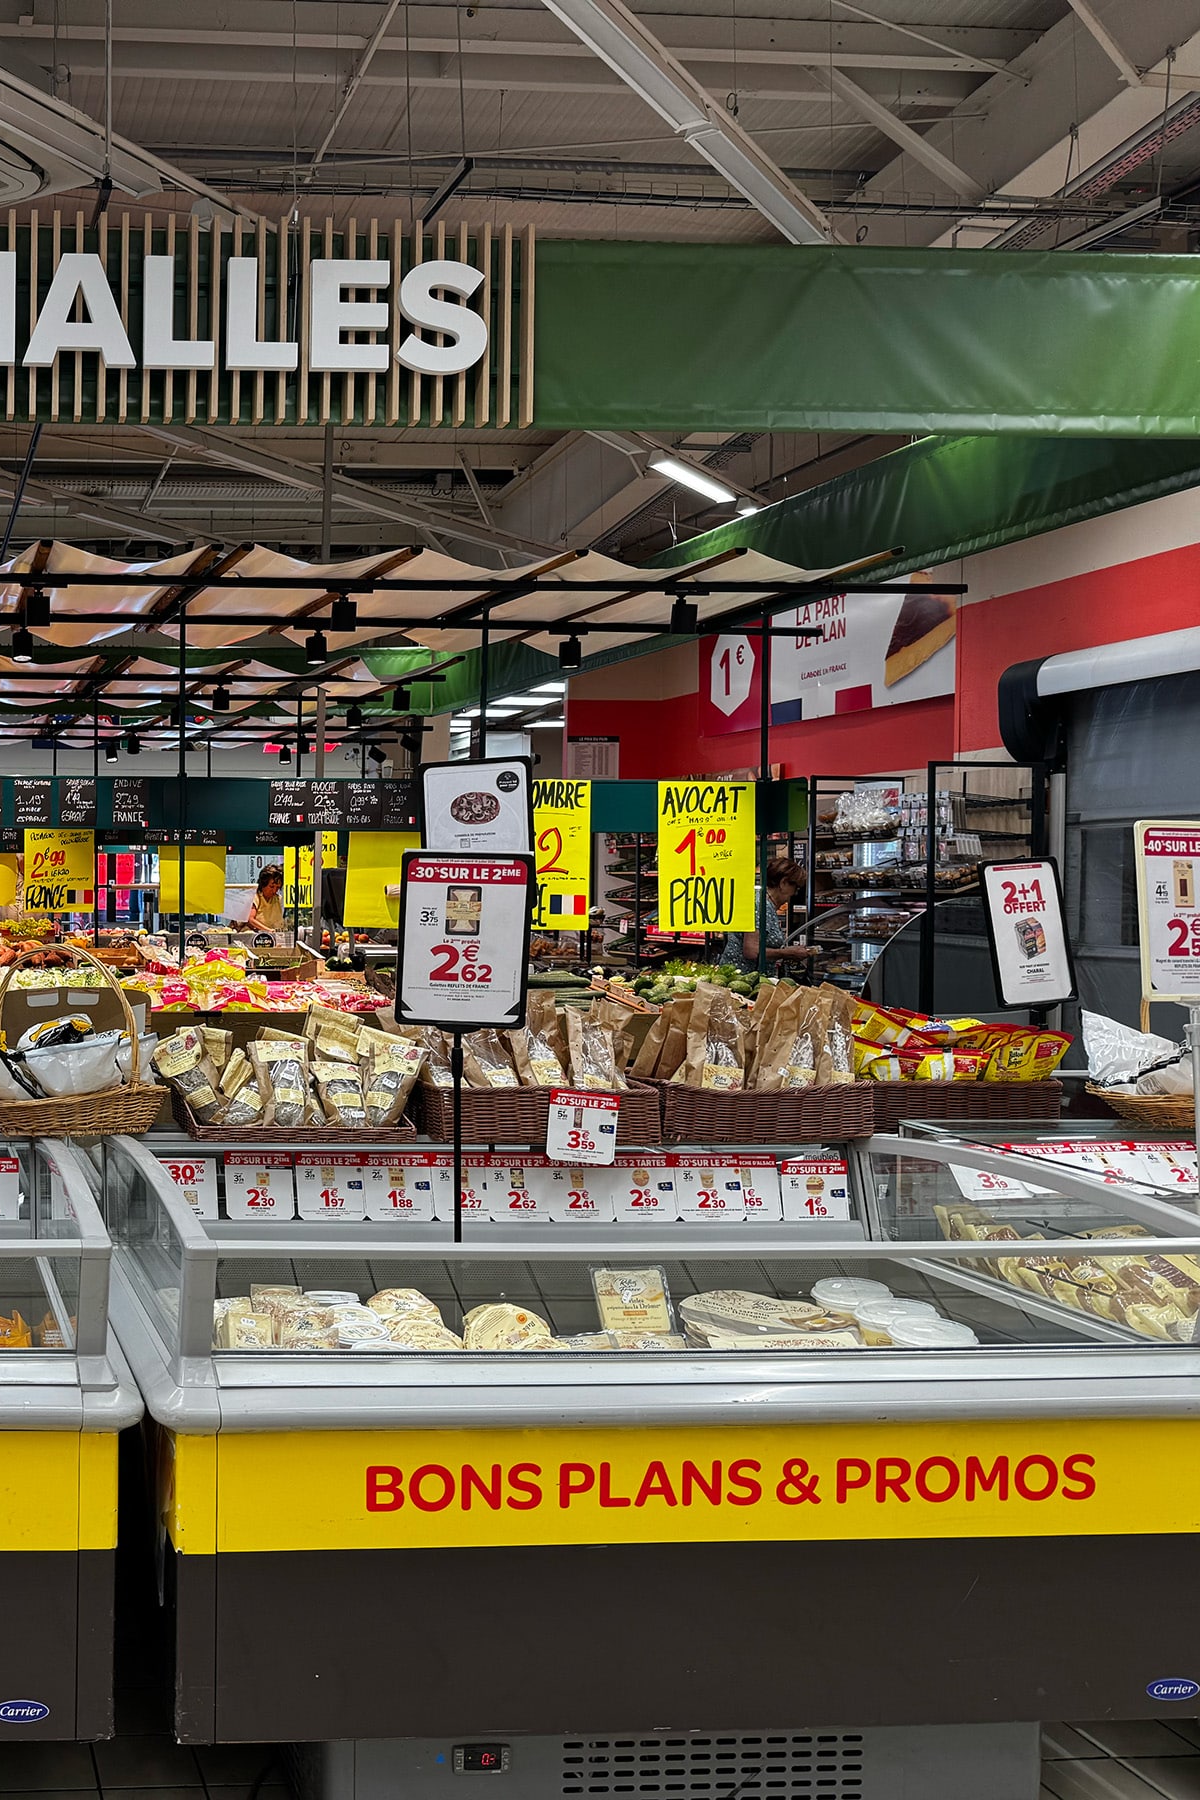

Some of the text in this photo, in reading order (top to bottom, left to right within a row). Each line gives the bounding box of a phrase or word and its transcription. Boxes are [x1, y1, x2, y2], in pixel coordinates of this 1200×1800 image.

[795, 593, 847, 627] LA PART
[795, 628, 811, 651] DE
[828, 662, 847, 674] FRANCE
[113, 779, 143, 788] ENDIVE
[311, 781, 337, 792] AVOCAT
[533, 781, 587, 810] OMBRE
[662, 786, 747, 818] AVOCAT
[112, 811, 144, 822] FRANCE
[1165, 840, 1187, 852] SUR
[410, 866, 439, 878] -30%
[439, 867, 470, 880] SUR
[473, 868, 490, 880] LE
[492, 866, 521, 881] 2ÈME
[25, 884, 68, 911] FRANCE
[1000, 879, 1043, 904] 2+1
[670, 876, 735, 927] PEROU
[1003, 900, 1047, 914] OFFERT
[429, 944, 493, 983] 2€62
[569, 1098, 587, 1106] SUR
[567, 1130, 596, 1150] 3€59
[243, 1157, 261, 1165] SUR
[262, 1157, 273, 1165] LE
[314, 1158, 332, 1166] SUR
[333, 1158, 343, 1166] LE
[382, 1158, 399, 1166] SUR
[400, 1158, 411, 1166] LE
[503, 1159, 520, 1167] SUR
[521, 1159, 532, 1167] LE
[691, 1159, 708, 1167] SUR
[710, 1159, 720, 1167] LE
[246, 1186, 275, 1207] 2€30
[320, 1187, 345, 1208] 1€97
[388, 1189, 413, 1208] 1€88
[508, 1189, 537, 1209] 2€62
[568, 1190, 595, 1209] 2€41
[630, 1189, 658, 1207] 2€99
[697, 1190, 726, 1209] 2€30
[365, 1453, 1096, 1512] BONS PLANS & PROMOS
[1153, 1684, 1194, 1695] Carrier
[0, 1706, 42, 1717] Carrier
